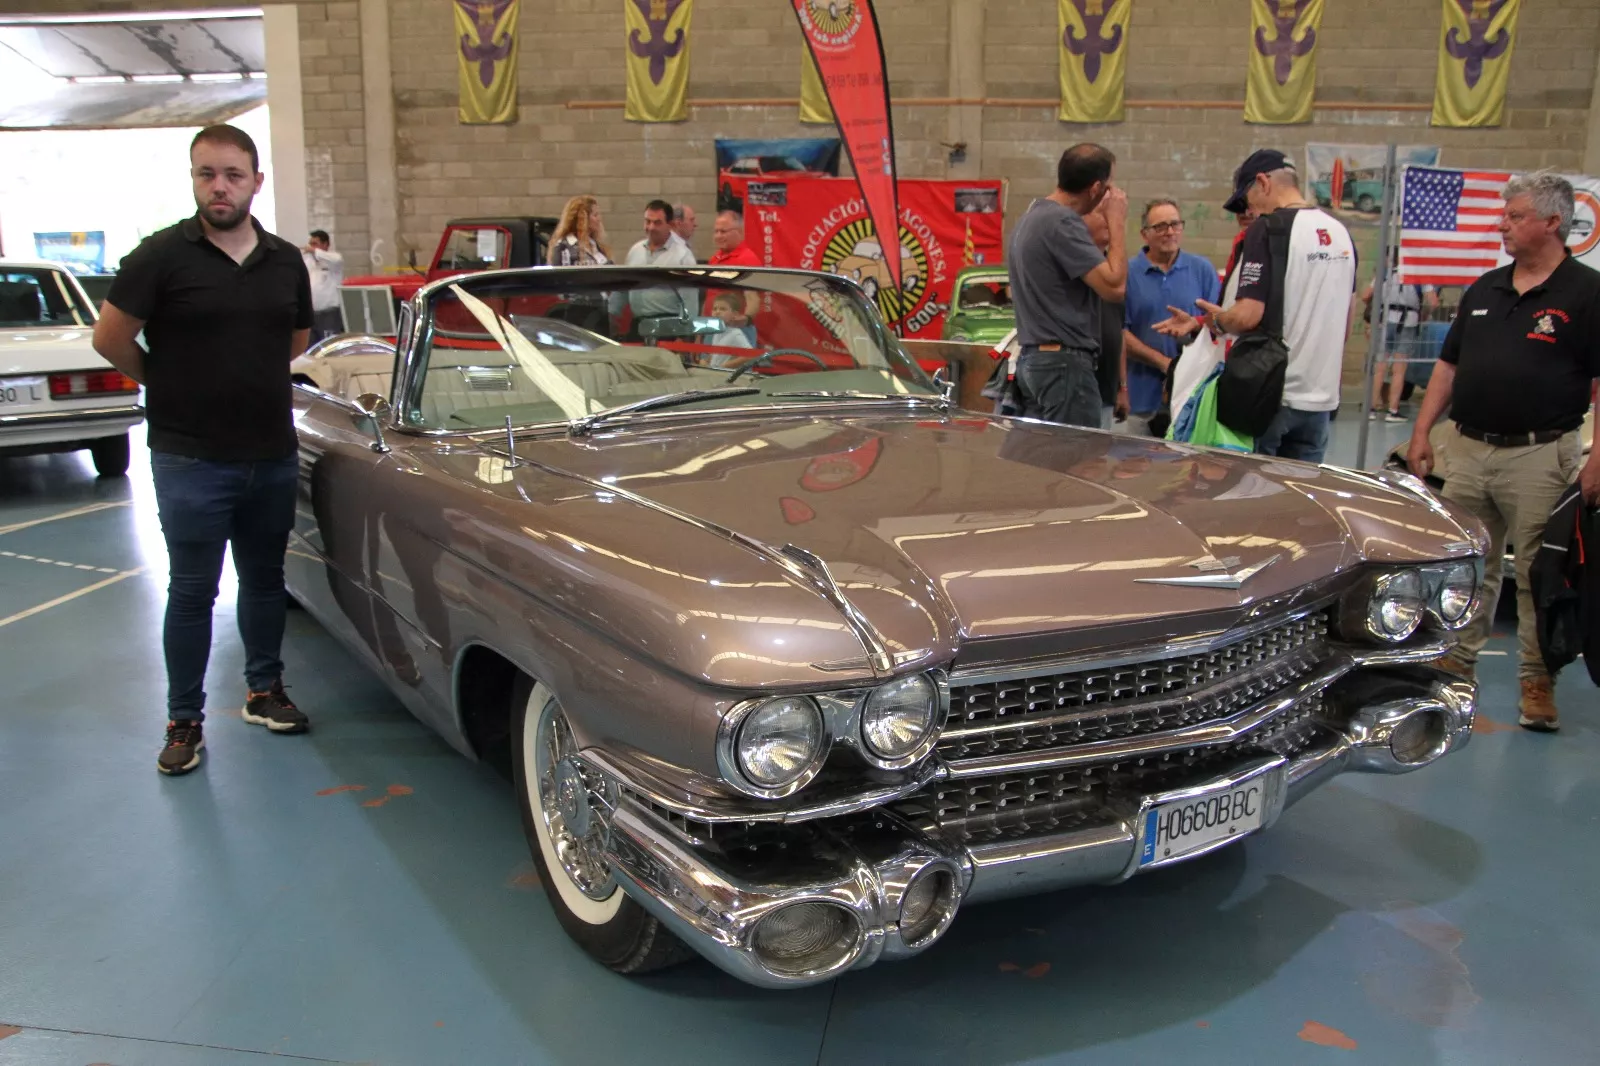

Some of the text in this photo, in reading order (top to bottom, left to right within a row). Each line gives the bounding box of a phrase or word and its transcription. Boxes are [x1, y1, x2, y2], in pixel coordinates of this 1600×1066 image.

[758, 210, 781, 222] Tel.
[801, 197, 947, 284] SOCIACIÓ AGONESA
[370, 238, 385, 266] 6
[29, 386, 42, 401] L
[1157, 787, 1259, 846] H0660BBC
[1143, 843, 1152, 856] E
